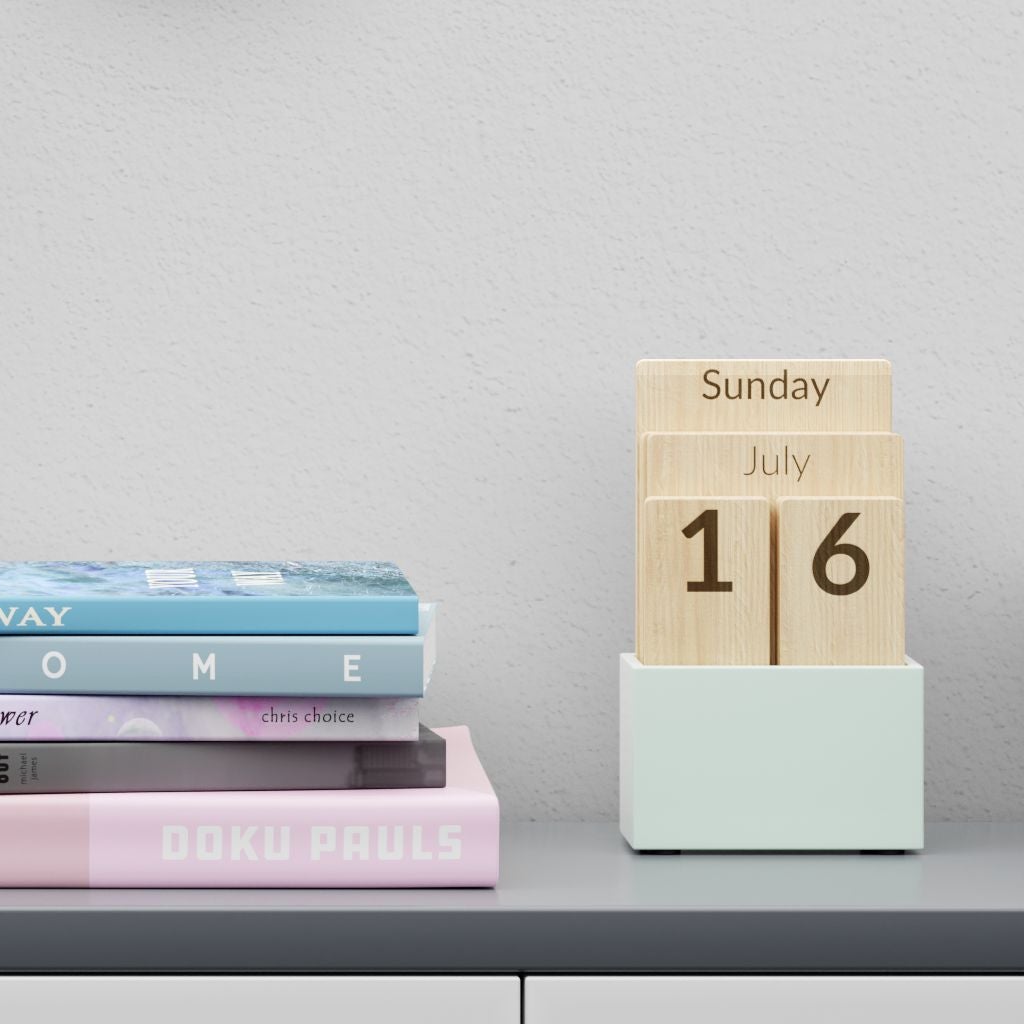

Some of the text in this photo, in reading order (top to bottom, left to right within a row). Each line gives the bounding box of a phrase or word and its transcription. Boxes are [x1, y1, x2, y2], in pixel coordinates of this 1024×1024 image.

[701, 368, 831, 407] Sunday
[743, 445, 811, 482] July
[261, 707, 355, 724] chris choice
[162, 825, 463, 861] DOKU PAULS
